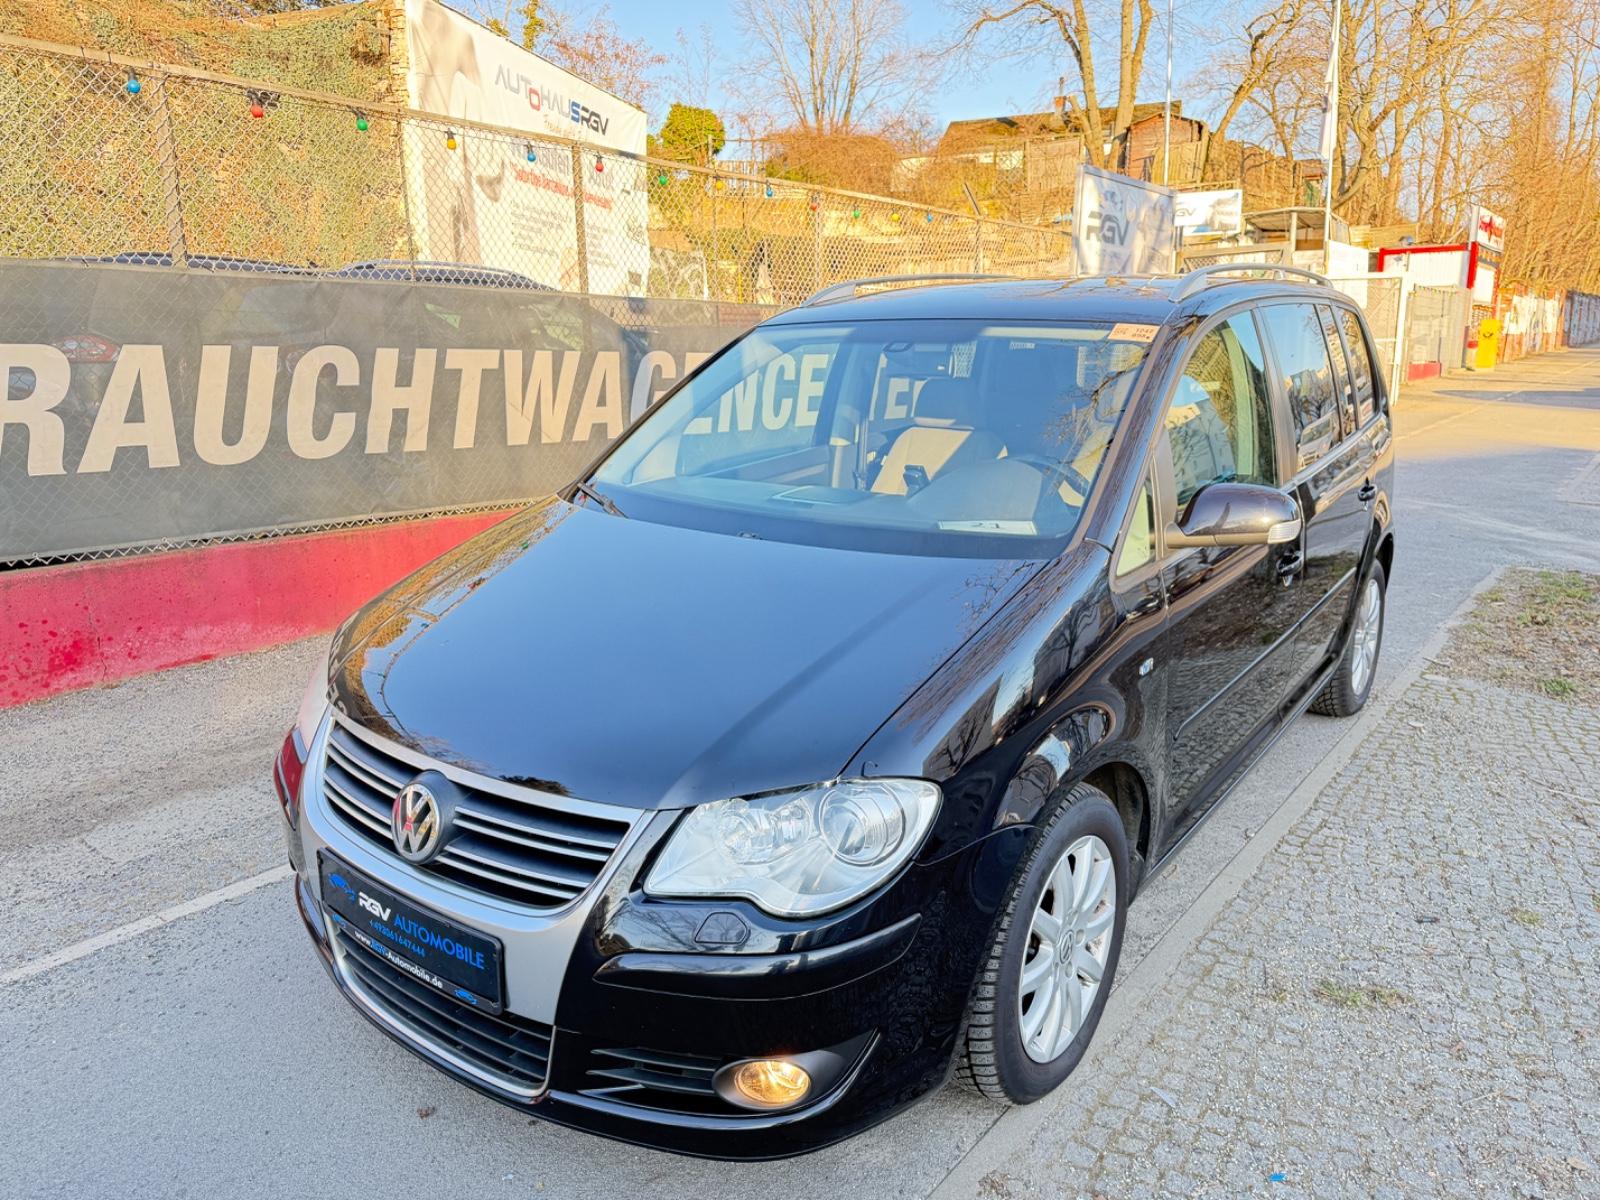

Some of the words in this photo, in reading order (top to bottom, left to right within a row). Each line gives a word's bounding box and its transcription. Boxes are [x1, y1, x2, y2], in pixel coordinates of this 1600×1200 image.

[1086, 211, 1129, 246] RGV
[358, 891, 391, 922] RGV
[393, 913, 485, 970] AUTOMOBILE
